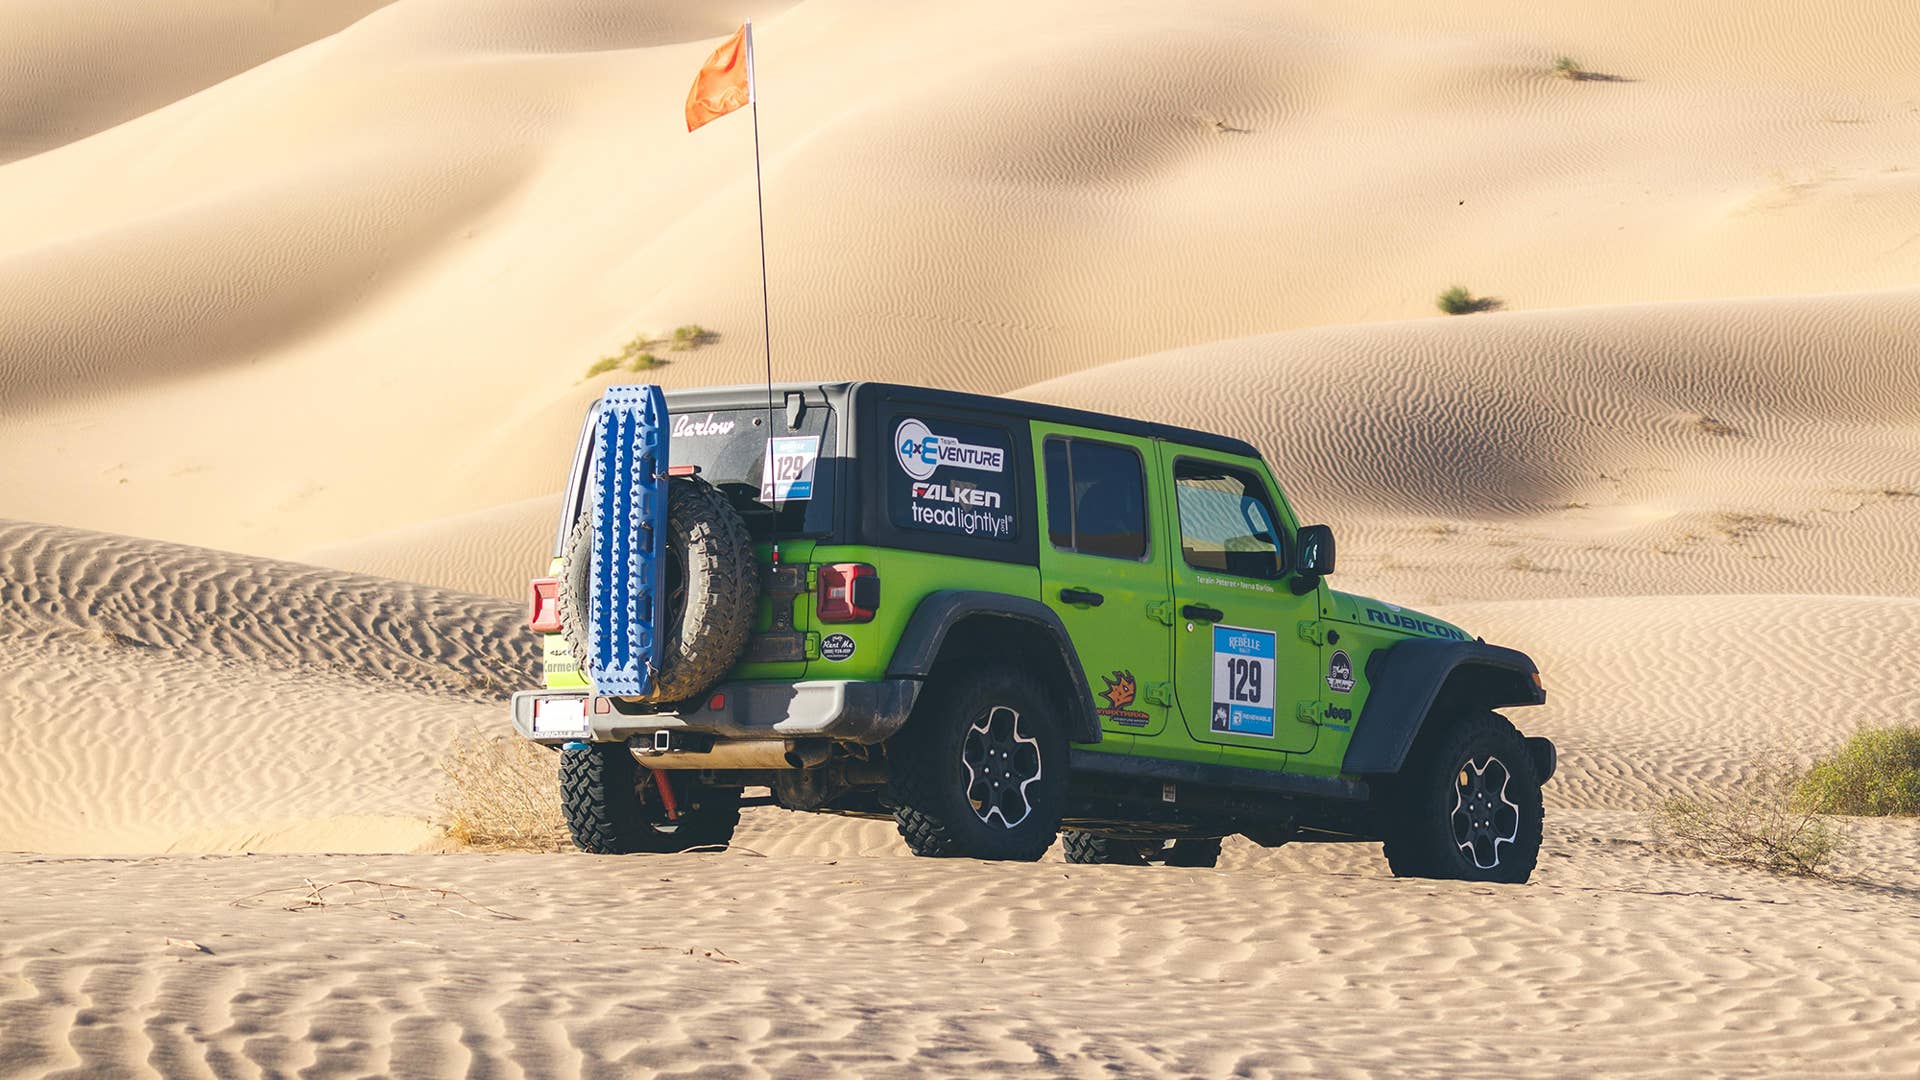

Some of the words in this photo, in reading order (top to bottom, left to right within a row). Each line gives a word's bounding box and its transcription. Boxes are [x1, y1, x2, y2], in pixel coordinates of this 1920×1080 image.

[672, 411, 735, 438] Barlow
[776, 455, 804, 481] 129
[911, 482, 1001, 508] FALKEN
[1366, 608, 1465, 641] RUBICON
[822, 640, 839, 648] Rent
[841, 640, 853, 648] Me
[1229, 636, 1261, 651] REBELLE
[1227, 657, 1262, 703] 129
[1324, 702, 1352, 724] Jeep
